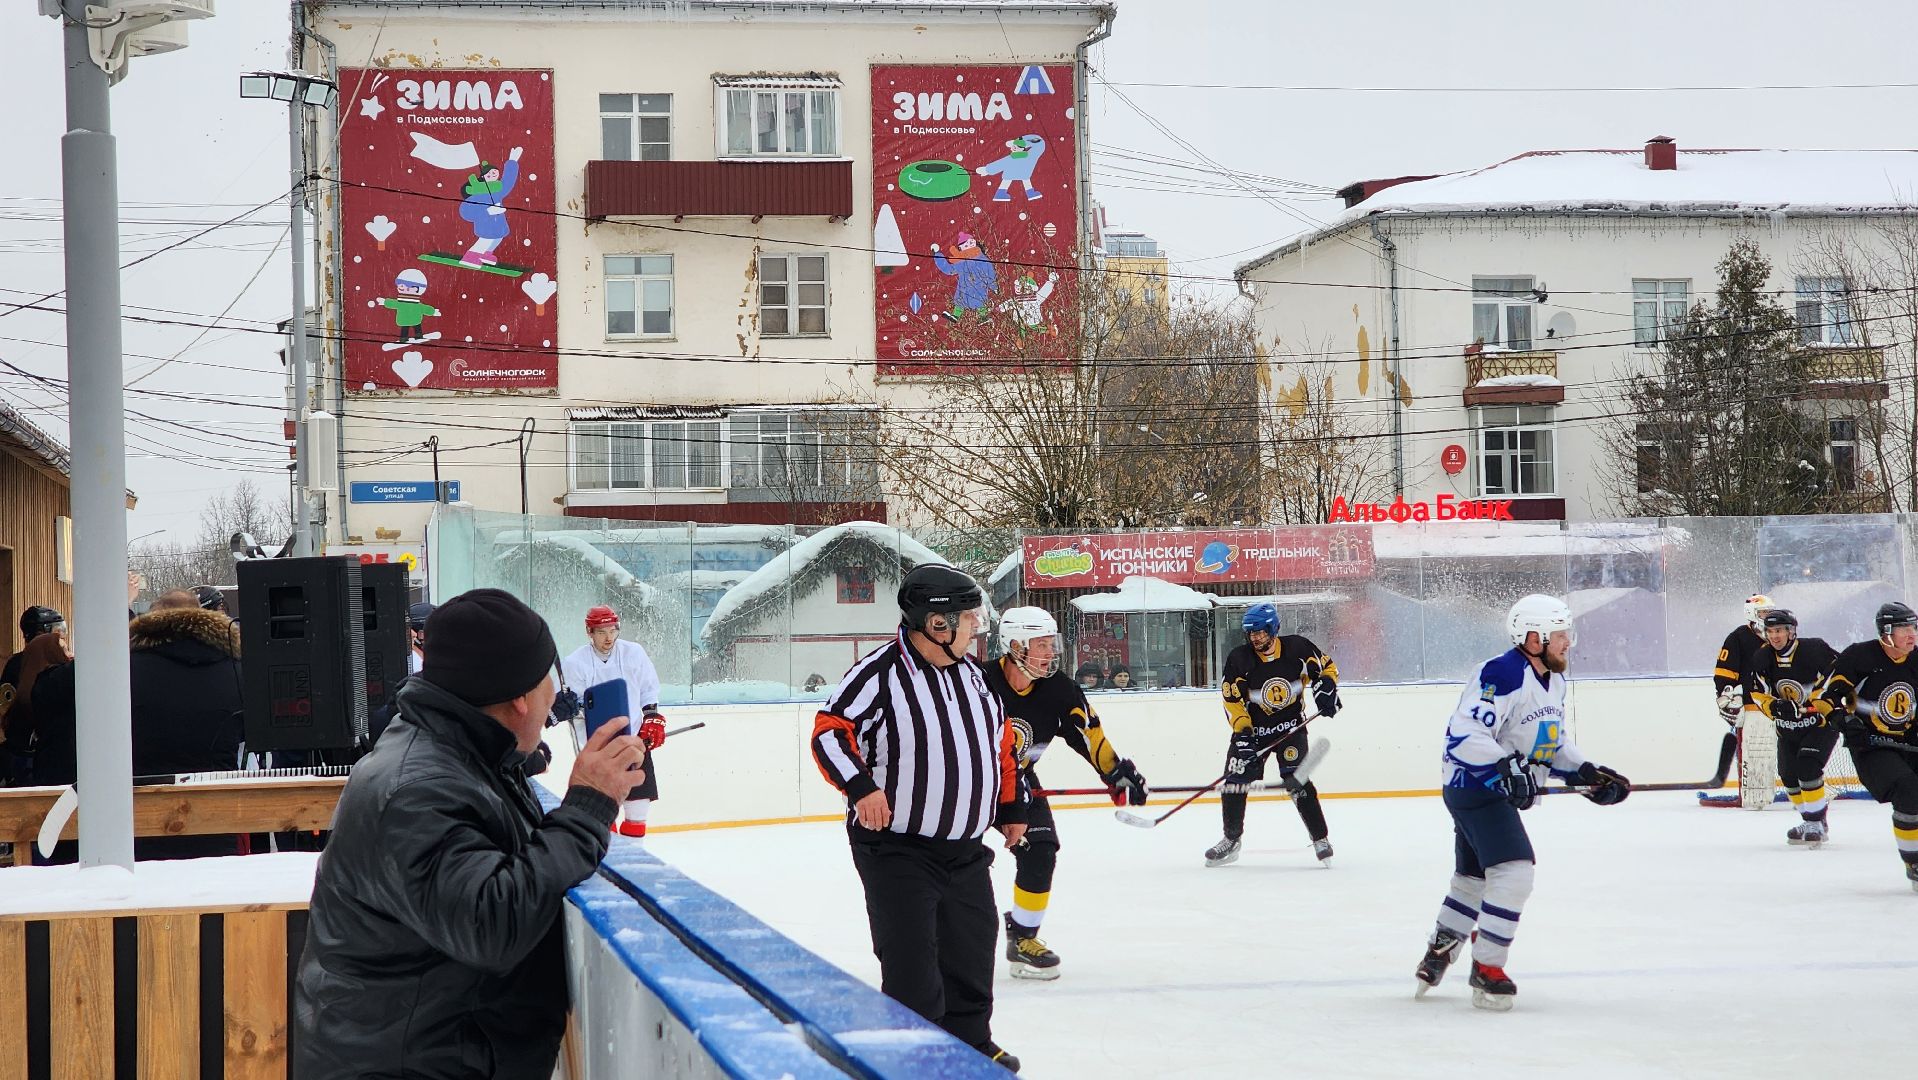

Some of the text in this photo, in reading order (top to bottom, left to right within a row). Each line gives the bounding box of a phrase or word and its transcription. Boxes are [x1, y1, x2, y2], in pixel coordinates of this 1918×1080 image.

[397, 80, 524, 110] ЗИМА
[893, 92, 1013, 121] ЗИМА
[407, 114, 485, 125] Подмосковье
[903, 125, 975, 135] Подмосковье
[462, 369, 546, 377] СОЛНЕЧНОГОРСК
[372, 485, 417, 494] Советская
[1327, 493, 1515, 524] Альфа Банк
[1100, 545, 1194, 561] ИСПАНСКИЕ
[1242, 546, 1321, 561] ТРДЕЛЬНИК
[1110, 560, 1188, 575] ПОНЧИКИ
[1470, 705, 1496, 728] 10
